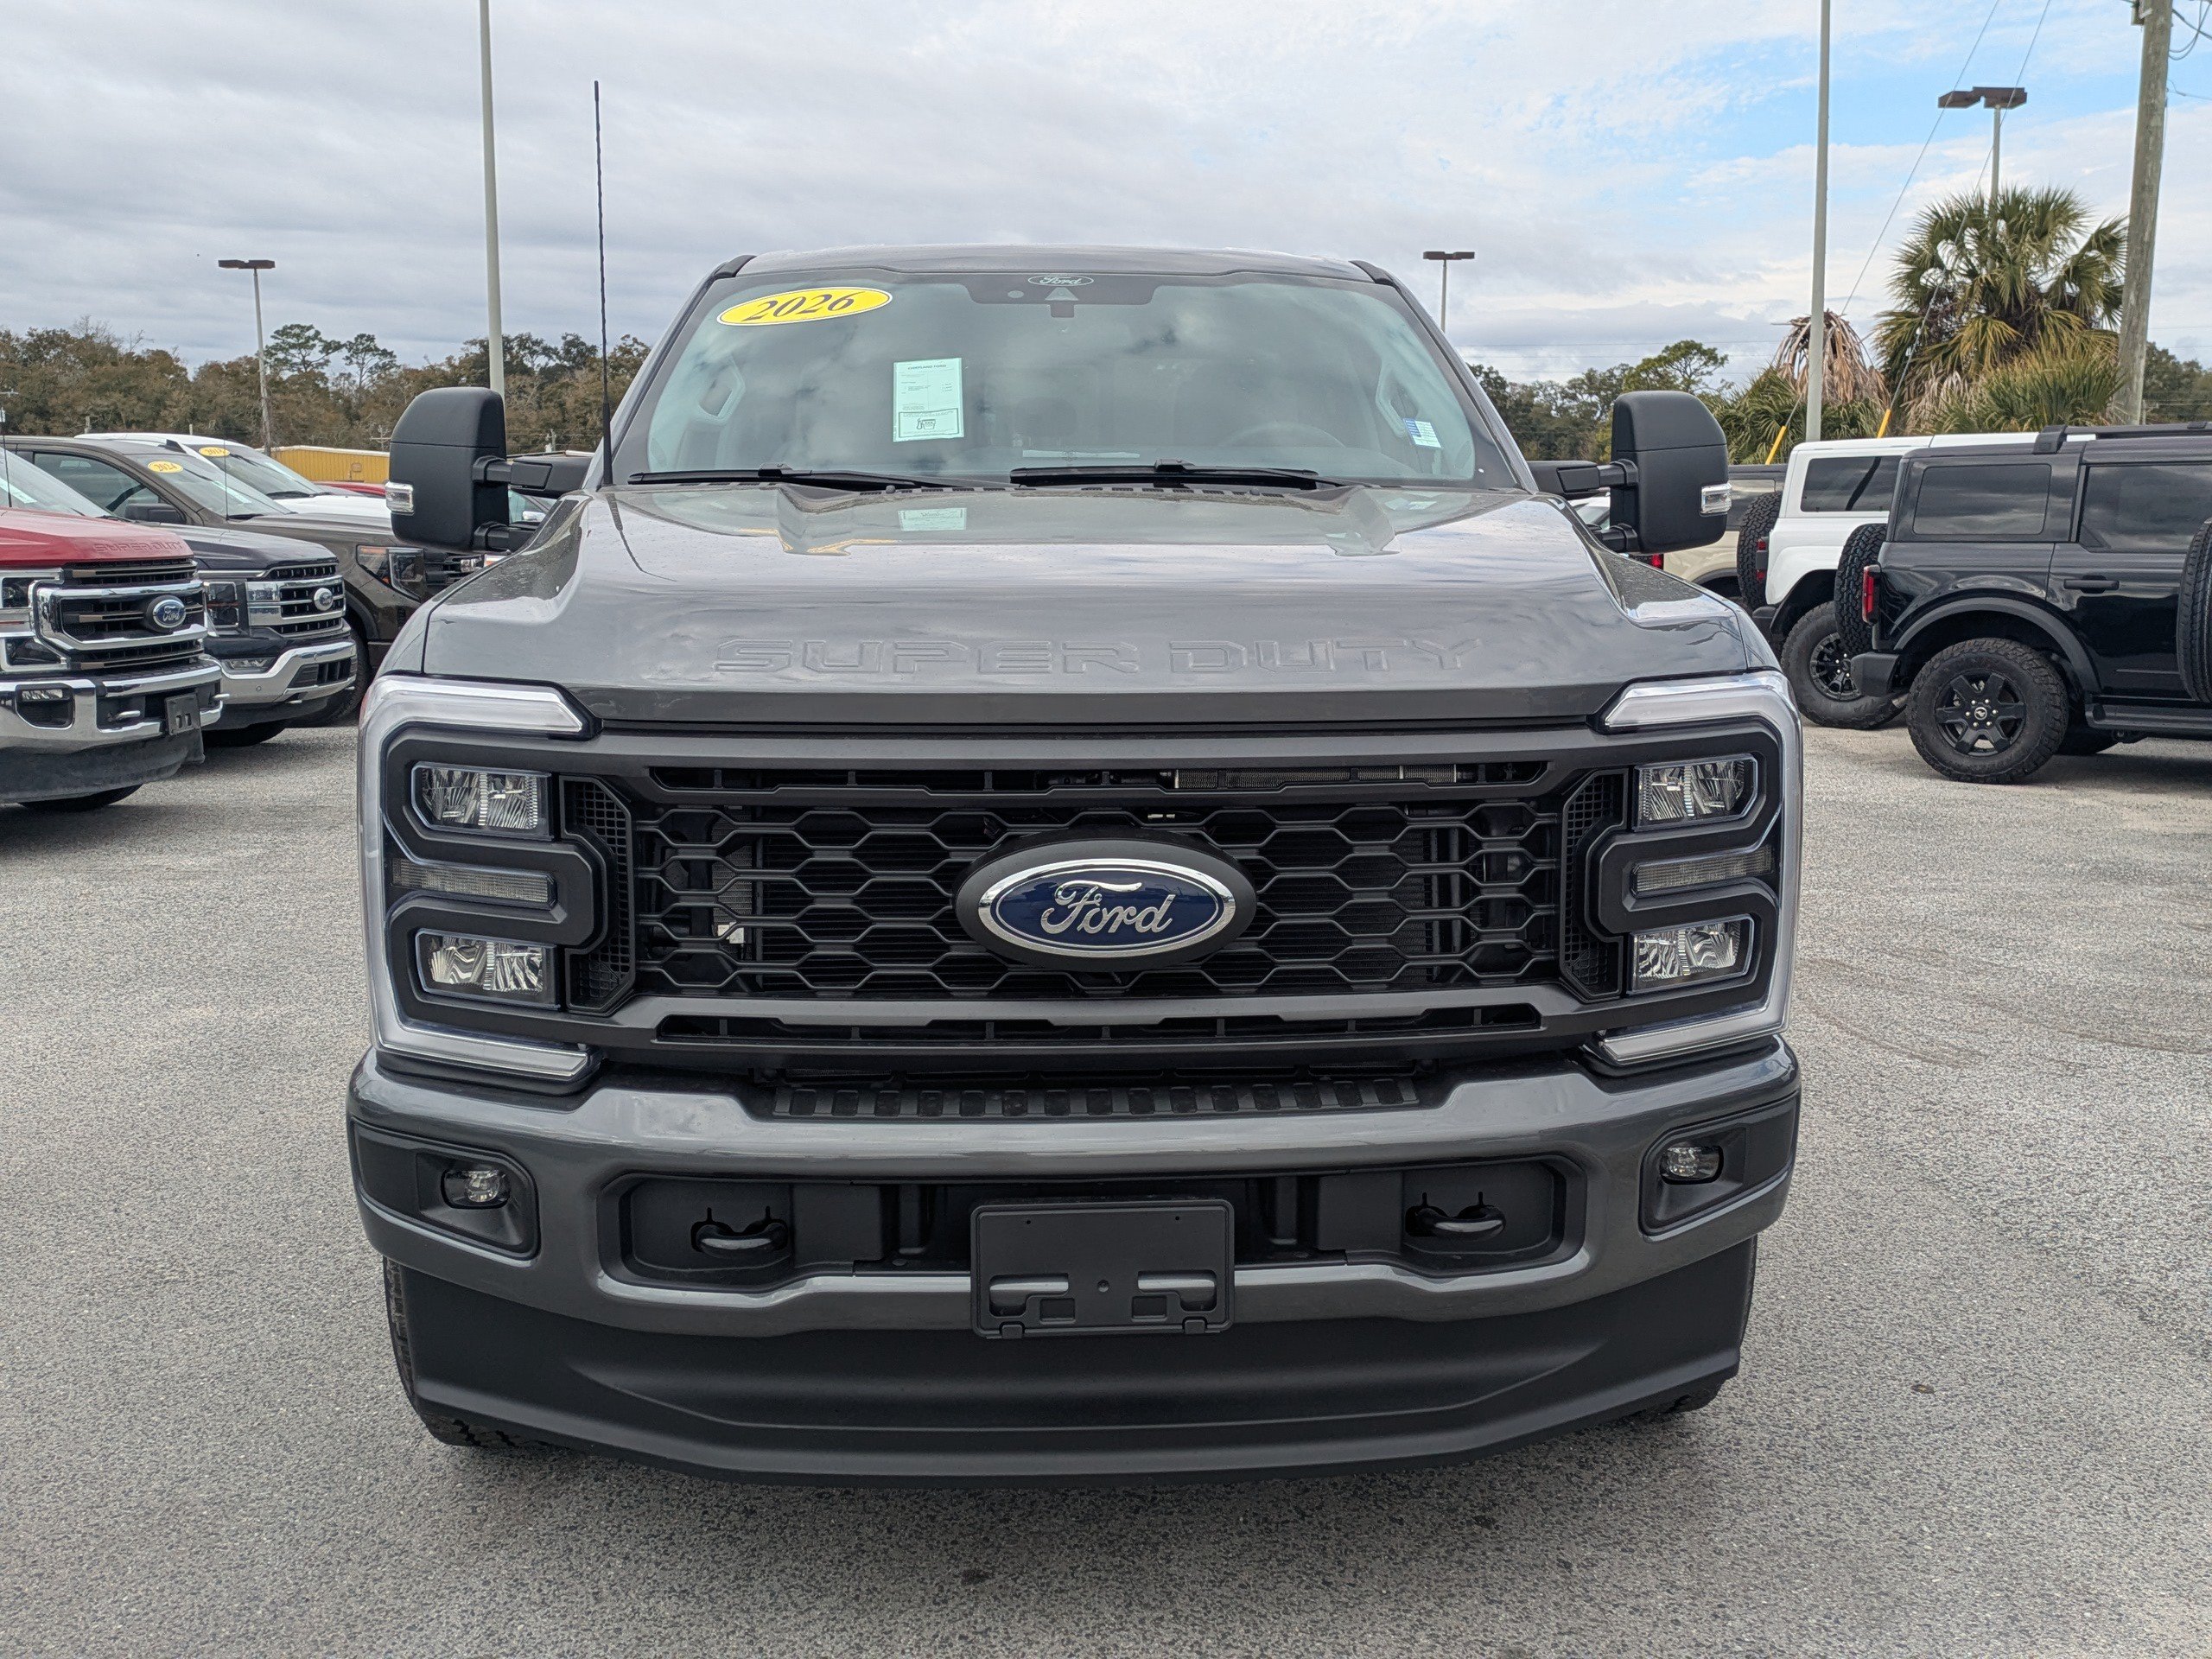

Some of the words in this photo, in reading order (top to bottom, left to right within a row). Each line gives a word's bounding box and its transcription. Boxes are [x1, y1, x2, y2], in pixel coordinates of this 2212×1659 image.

[1039, 275, 1083, 285] Ford
[741, 290, 867, 323] 2026
[153, 462, 179, 473] 2024
[92, 543, 151, 552] SUPER
[151, 541, 183, 550] DUTY
[162, 605, 181, 622] Ford
[715, 639, 1140, 675] SUPER
[1169, 637, 1482, 673] DUTY
[1040, 879, 1177, 935] Ford
